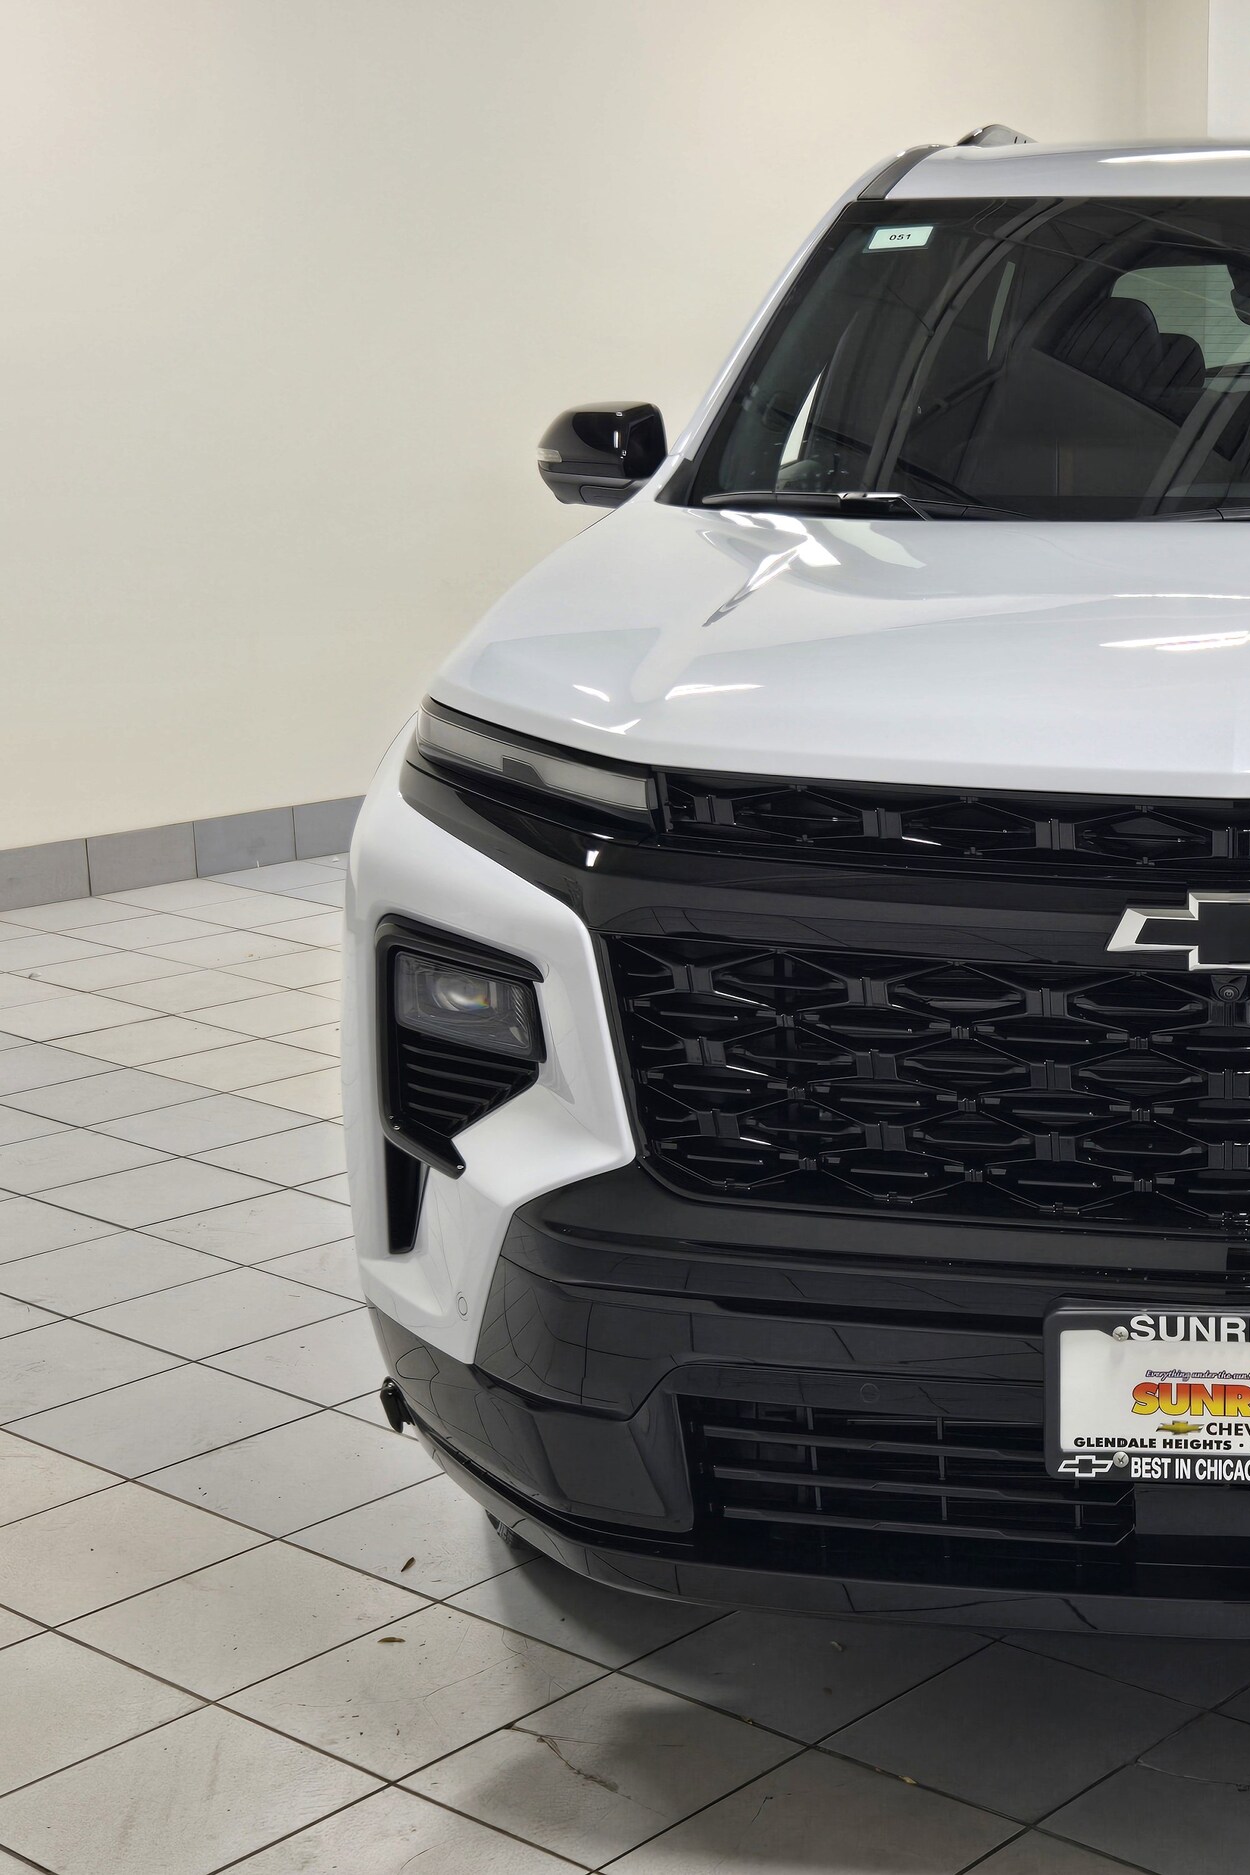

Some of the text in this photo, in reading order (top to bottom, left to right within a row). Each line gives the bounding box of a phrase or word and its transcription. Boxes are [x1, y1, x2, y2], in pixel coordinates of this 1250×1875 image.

[1145, 1369, 1191, 1381] Everything
[1191, 1370, 1218, 1380] under
[1219, 1369, 1232, 1380] the
[1073, 1437, 1157, 1449] GLENDALE
[1162, 1438, 1232, 1451] HEIGHTS
[1130, 1456, 1172, 1479] BEST
[1174, 1458, 1191, 1479] IN
